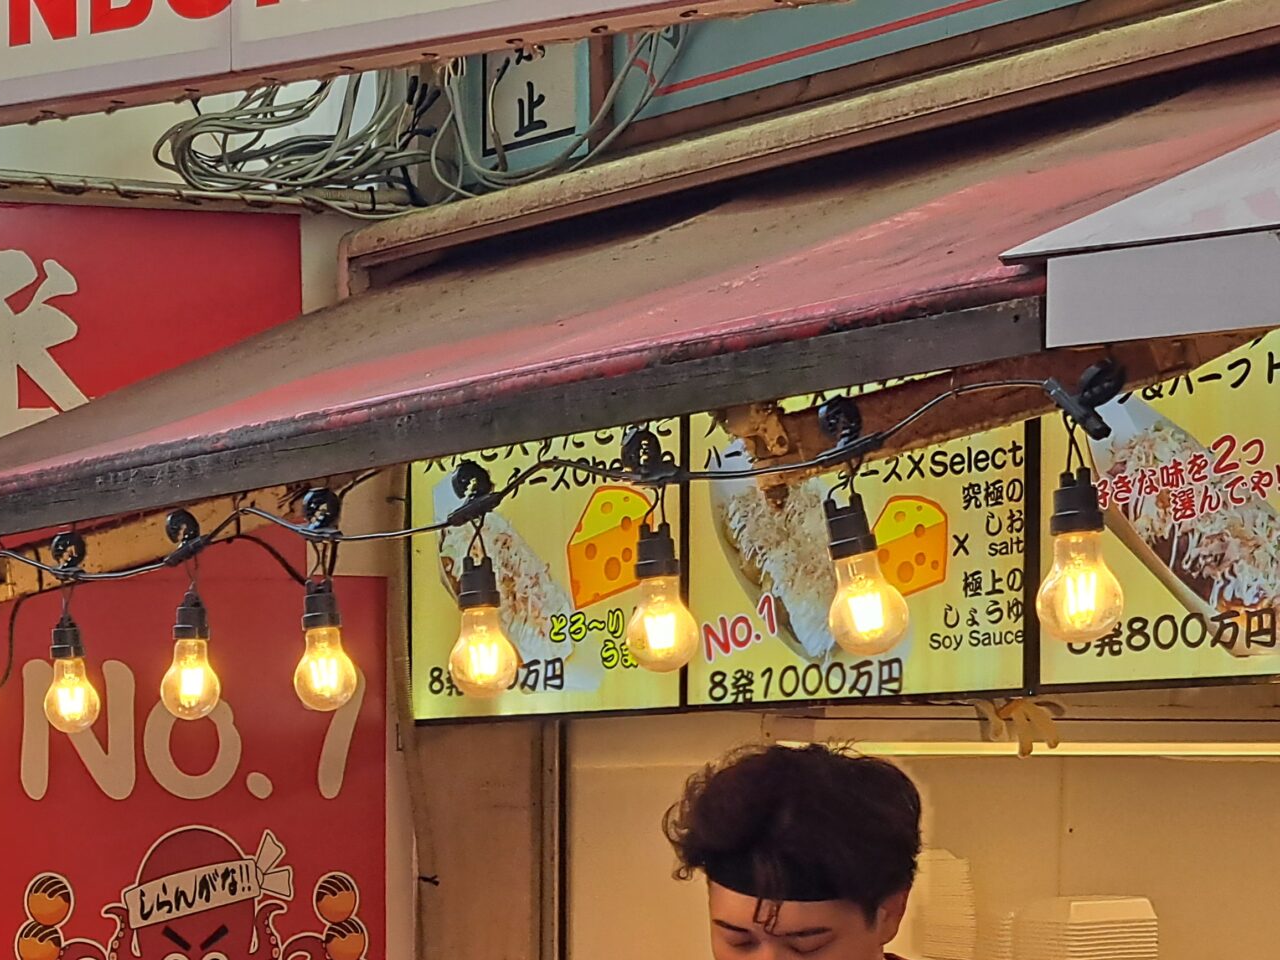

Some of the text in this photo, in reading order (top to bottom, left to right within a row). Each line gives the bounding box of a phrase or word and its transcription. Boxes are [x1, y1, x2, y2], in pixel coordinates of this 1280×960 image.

[962, 479, 1024, 510] 究極の
[986, 512, 1024, 537] しお
[988, 536, 1024, 556] salt
[963, 568, 1024, 598] 極上の
[944, 600, 1024, 629] しょうゆ
[929, 628, 1024, 652] Soy Sauce
[708, 658, 903, 702] 8発1000万円
